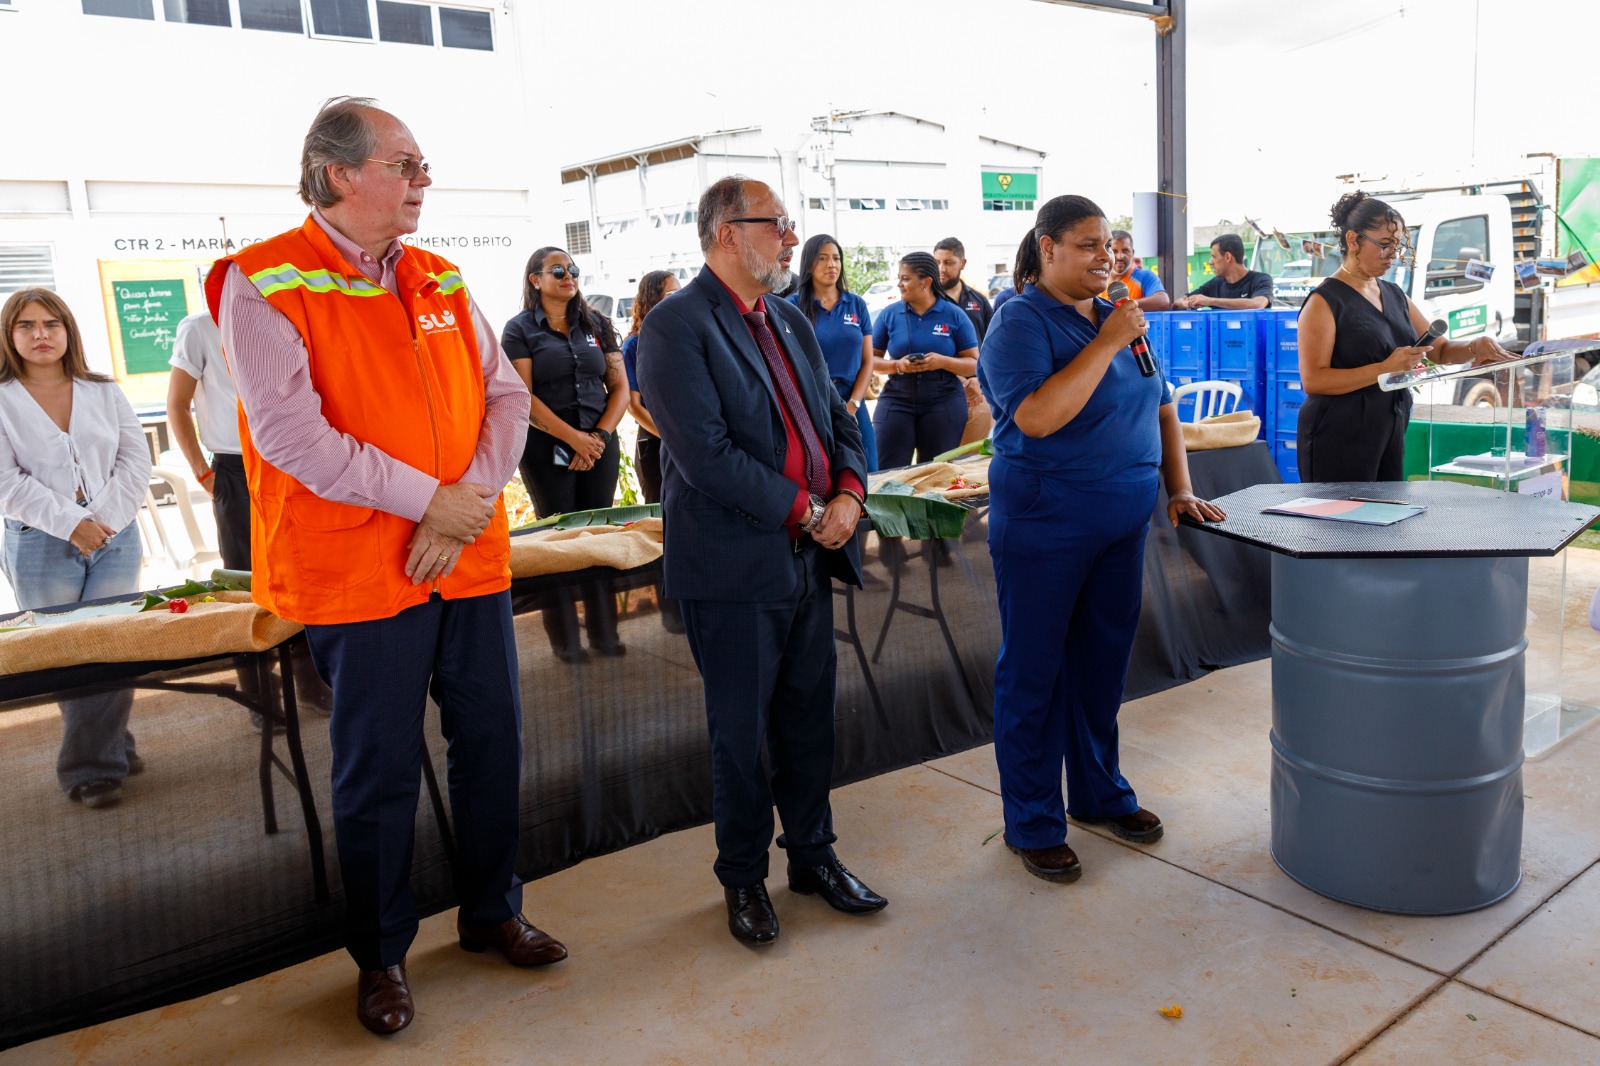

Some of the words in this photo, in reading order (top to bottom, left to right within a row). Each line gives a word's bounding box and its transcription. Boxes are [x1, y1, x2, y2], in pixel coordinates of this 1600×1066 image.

[114, 238, 149, 251] CTR
[155, 238, 164, 251] 2
[182, 238, 236, 250] MARIA
[473, 236, 512, 247] BRITO
[418, 309, 455, 330] SLU
